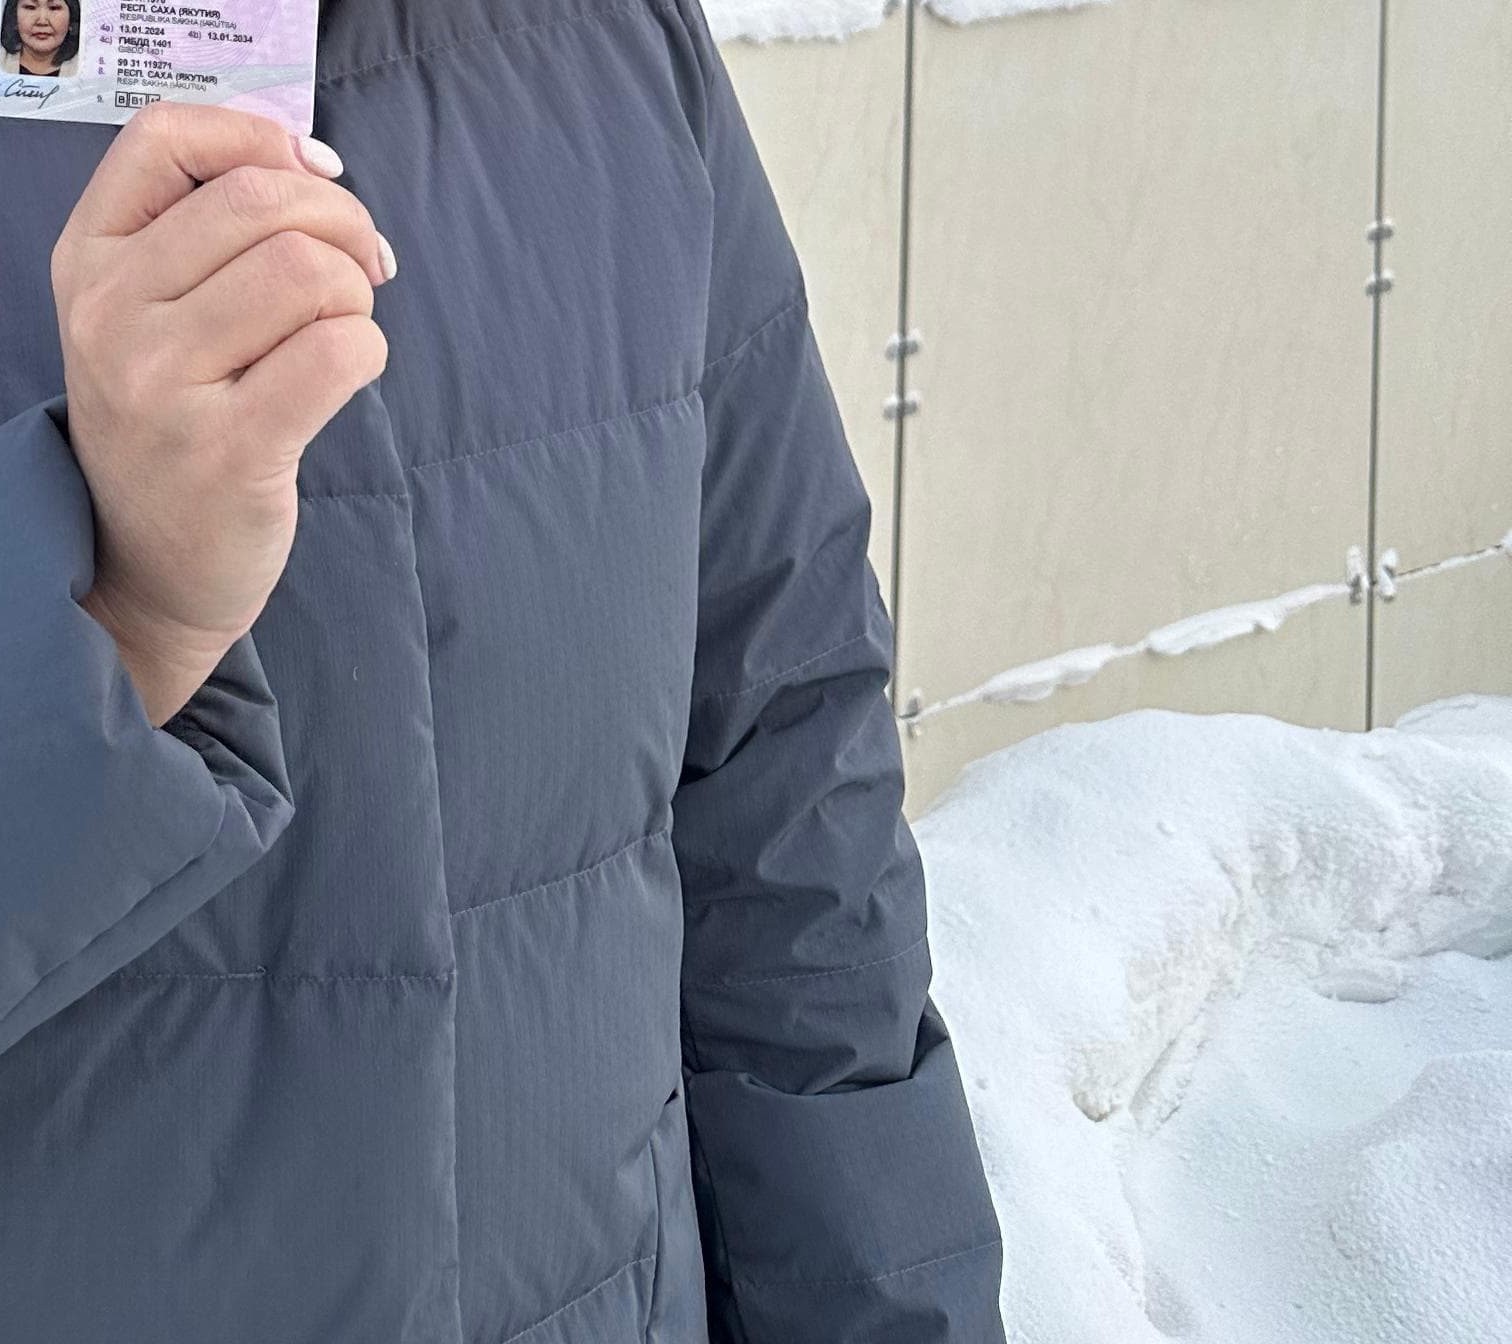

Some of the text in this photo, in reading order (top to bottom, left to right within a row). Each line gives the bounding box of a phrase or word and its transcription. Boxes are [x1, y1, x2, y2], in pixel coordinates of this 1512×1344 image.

[120, 3, 221, 20] РЕСП. САХА (ЯКУТИЯ)
[119, 25, 165, 36] 13.01.2024
[118, 37, 172, 48] ГИБДД 1401
[207, 32, 253, 43] 13.01.2034
[117, 69, 218, 86] РЕСП. САХА (ЯКУТИЯ)
